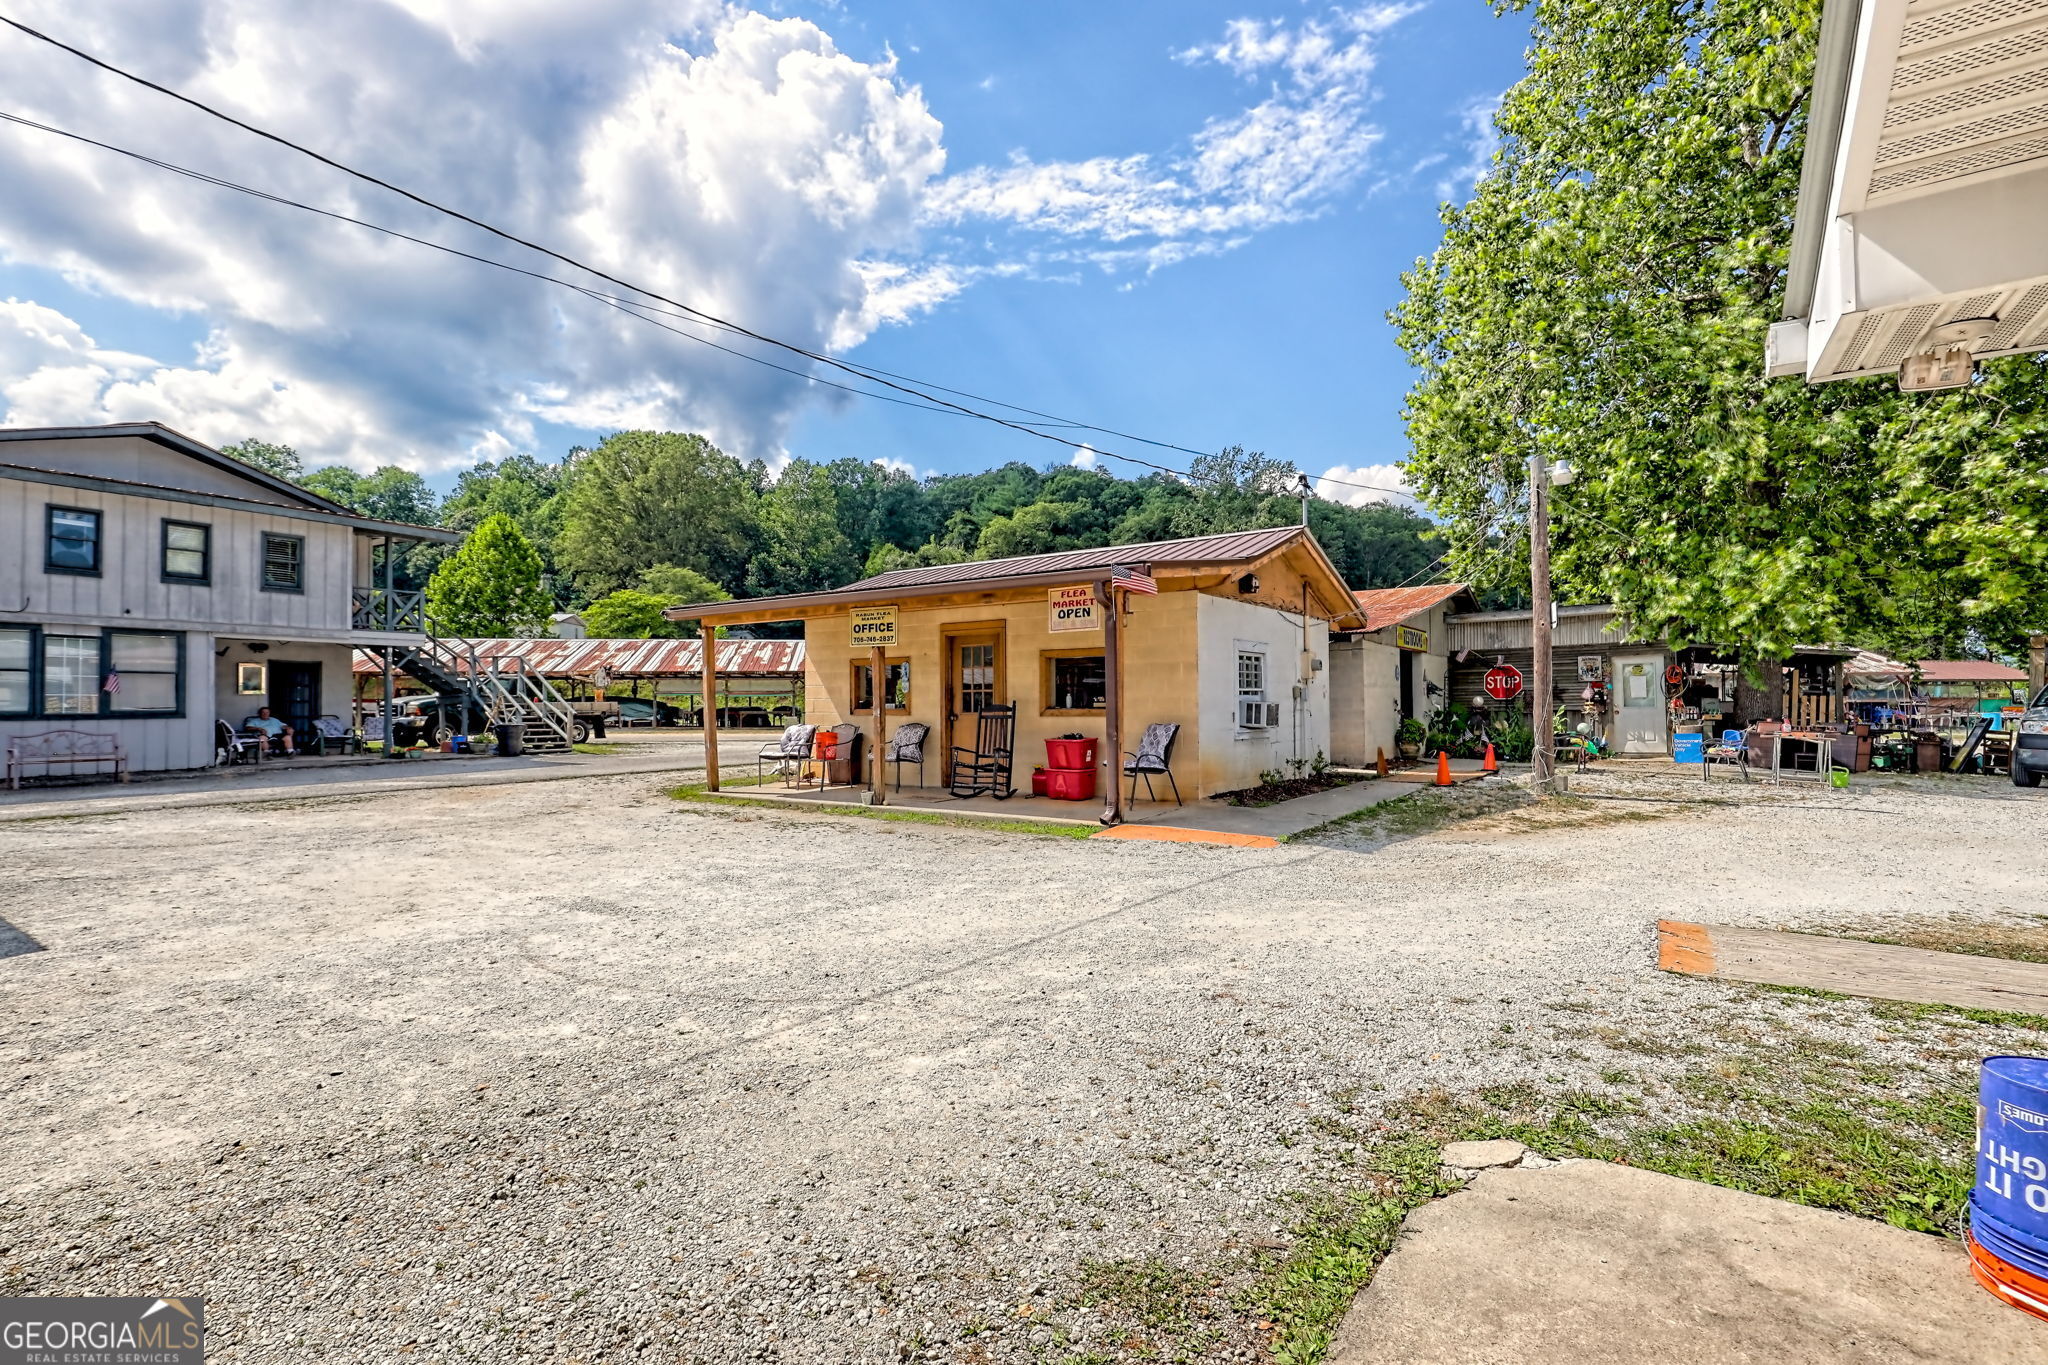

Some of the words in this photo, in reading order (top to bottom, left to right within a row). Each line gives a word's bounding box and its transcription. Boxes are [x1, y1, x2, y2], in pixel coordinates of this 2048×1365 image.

[1060, 589, 1087, 599] FLEA
[1052, 597, 1096, 609] MARKET
[1057, 607, 1091, 619] OPEN
[853, 622, 894, 634] OFFICE
[1487, 675, 1520, 689] STOP
[2003, 1105, 2048, 1127] OWE'S
[1985, 1139, 2047, 1181] GHT
[1985, 1165, 2011, 1200] IT
